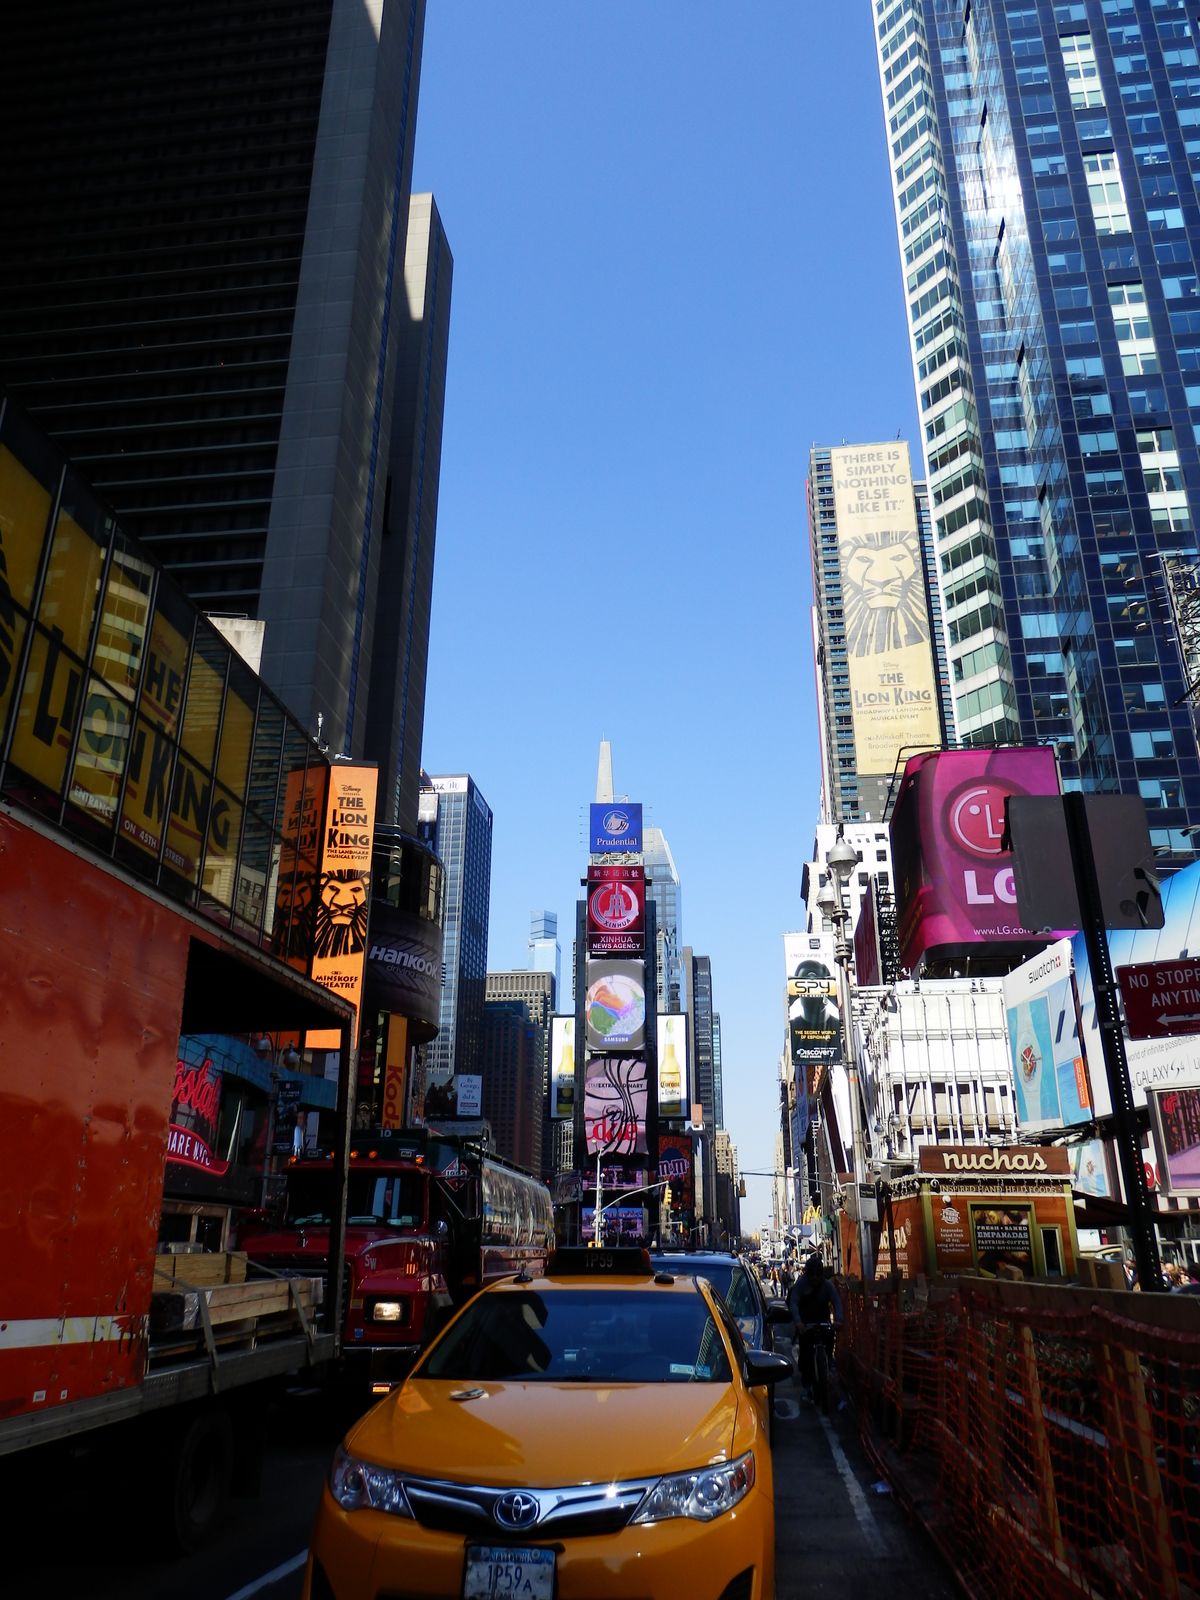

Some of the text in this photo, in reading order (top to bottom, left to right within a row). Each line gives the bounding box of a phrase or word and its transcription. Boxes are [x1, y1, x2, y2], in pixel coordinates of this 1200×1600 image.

[887, 450, 900, 460] IS
[846, 463, 896, 476] SIMPLY
[836, 474, 908, 490] NOTHING
[857, 488, 890, 500] ELSE
[848, 502, 880, 514] LIKE
[878, 672, 904, 684] THE
[855, 688, 931, 708] LION KING
[144, 719, 230, 851] KING
[338, 796, 364, 808] THE
[332, 809, 368, 827] LION
[124, 819, 137, 835] ON
[139, 830, 157, 850] 45TH
[164, 847, 185, 867] STREET
[327, 828, 370, 848] KING
[596, 837, 638, 846] Prudential
[604, 918, 631, 928] XINHUA
[369, 946, 438, 979] Hankook
[1028, 959, 1056, 984] swatch
[794, 981, 830, 994] SPY
[1128, 973, 1150, 989] NO
[797, 1048, 835, 1057] Discovery
[1136, 1064, 1169, 1086] GALAXY
[942, 1148, 1048, 1172] nuchas
[940, 1184, 976, 1193] INSPIRED
[978, 1184, 1002, 1193] HAND
[585, 1252, 614, 1268] 1P59
